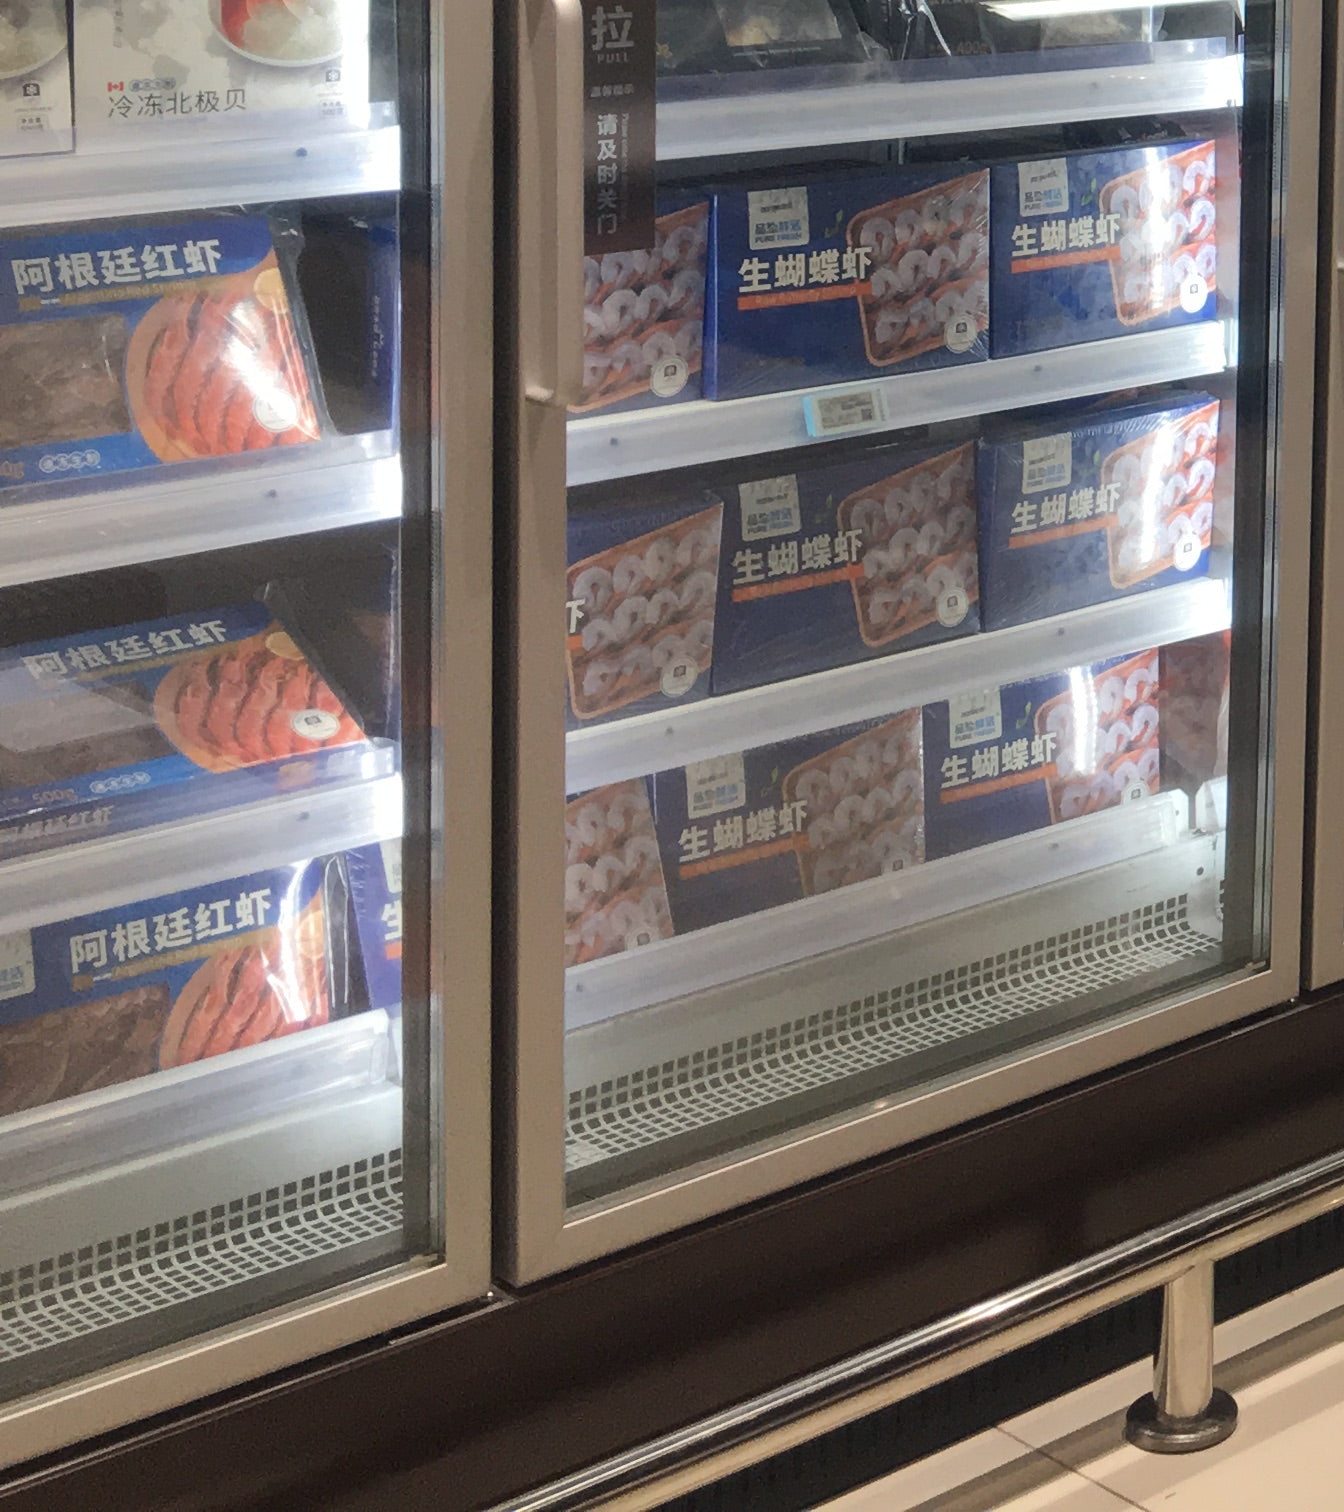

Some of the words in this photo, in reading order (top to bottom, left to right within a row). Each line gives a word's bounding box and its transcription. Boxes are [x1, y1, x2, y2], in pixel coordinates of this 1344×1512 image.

[591, 4, 635, 51] 拉
[107, 88, 247, 119] 冷冻北极贝
[596, 113, 619, 235] 请及时关门
[1011, 213, 1121, 257] 生蝴蝶虾
[10, 238, 222, 295] 阿根廷红虾
[738, 246, 873, 293] 生蝴蝶虾
[1010, 482, 1121, 534] 生蝴蝶虾
[731, 528, 863, 585] 生蝴蝶虾
[21, 619, 227, 680] 阿根廷红虾
[940, 731, 1057, 788] 生蝴蝶虾
[678, 799, 808, 863] 生蝴蝶虾
[69, 888, 273, 974] 阿根廷红虾
